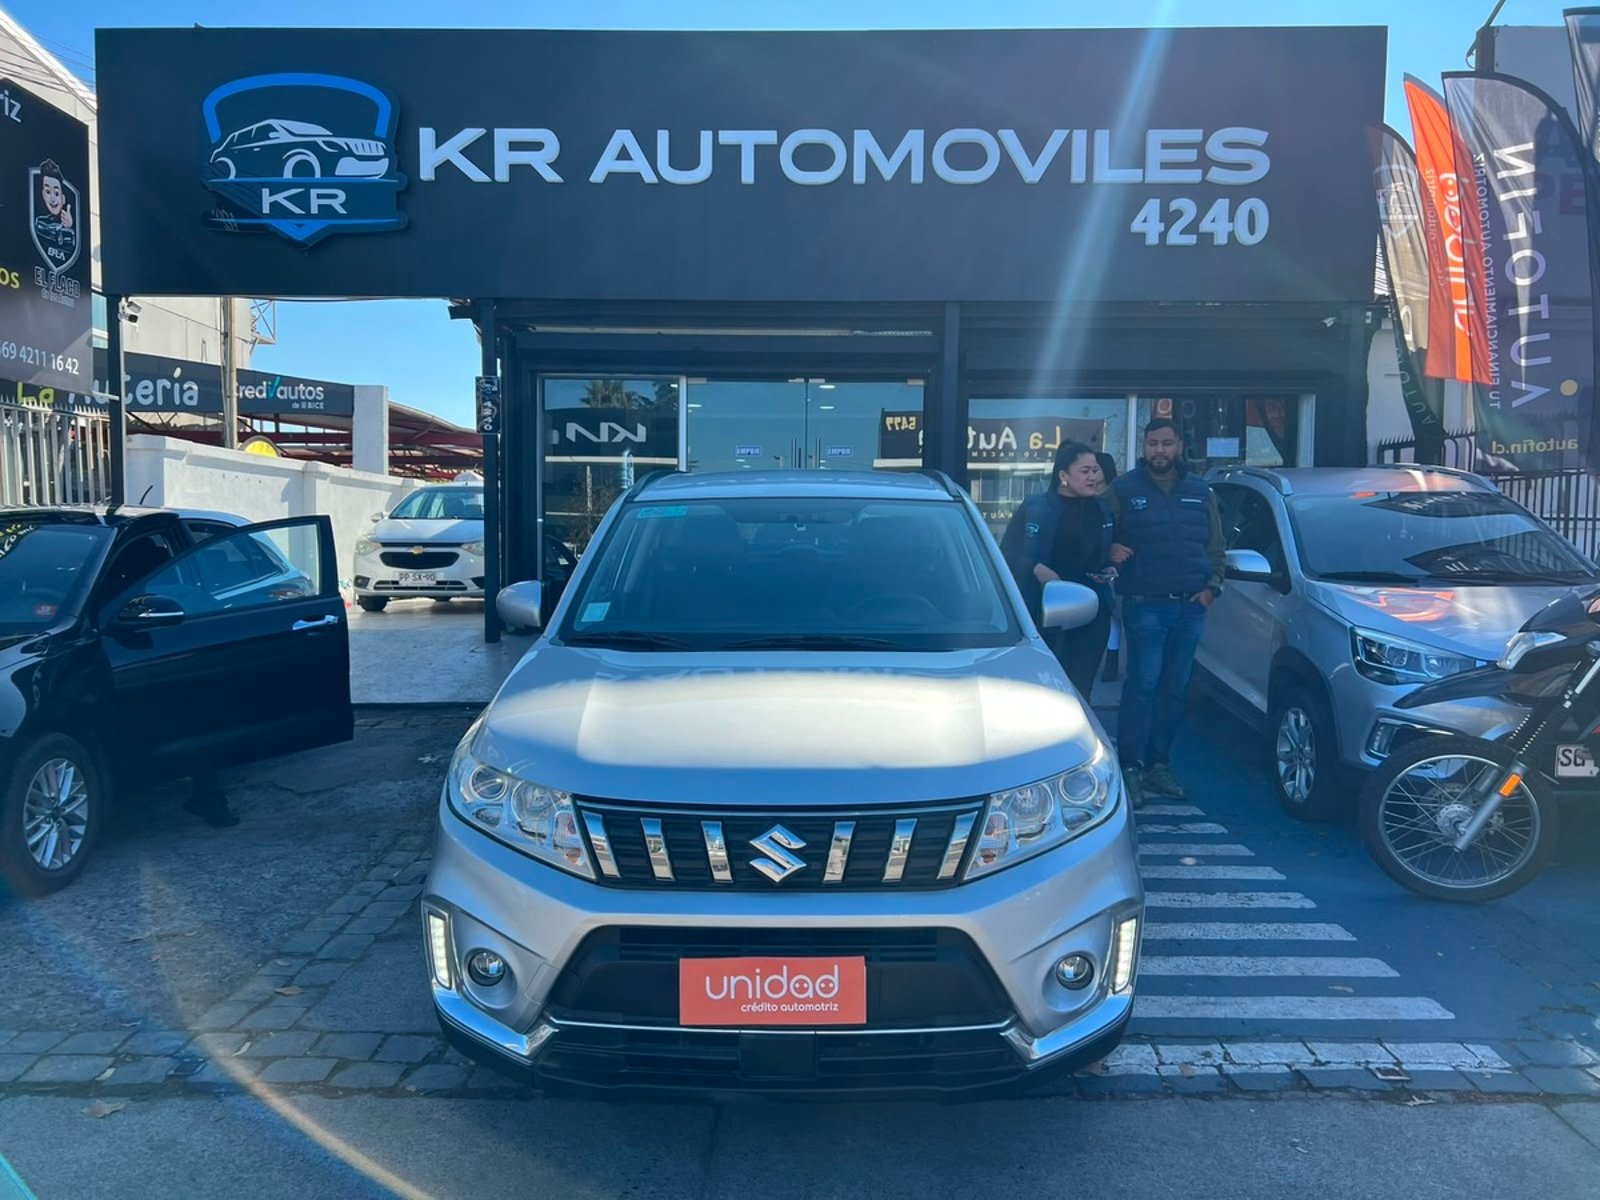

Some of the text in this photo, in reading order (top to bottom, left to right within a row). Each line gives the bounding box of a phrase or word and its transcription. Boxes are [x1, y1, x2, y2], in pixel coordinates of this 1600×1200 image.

[0, 89, 21, 123] iz
[418, 127, 1271, 186] KR AUTOMOVILES
[262, 187, 348, 215] KR
[1131, 197, 1270, 247] 4240
[0, 340, 17, 360] 69
[19, 345, 47, 367] 4211
[705, 964, 840, 1000] unidad
[740, 1001, 840, 1013] crédito automotriz
